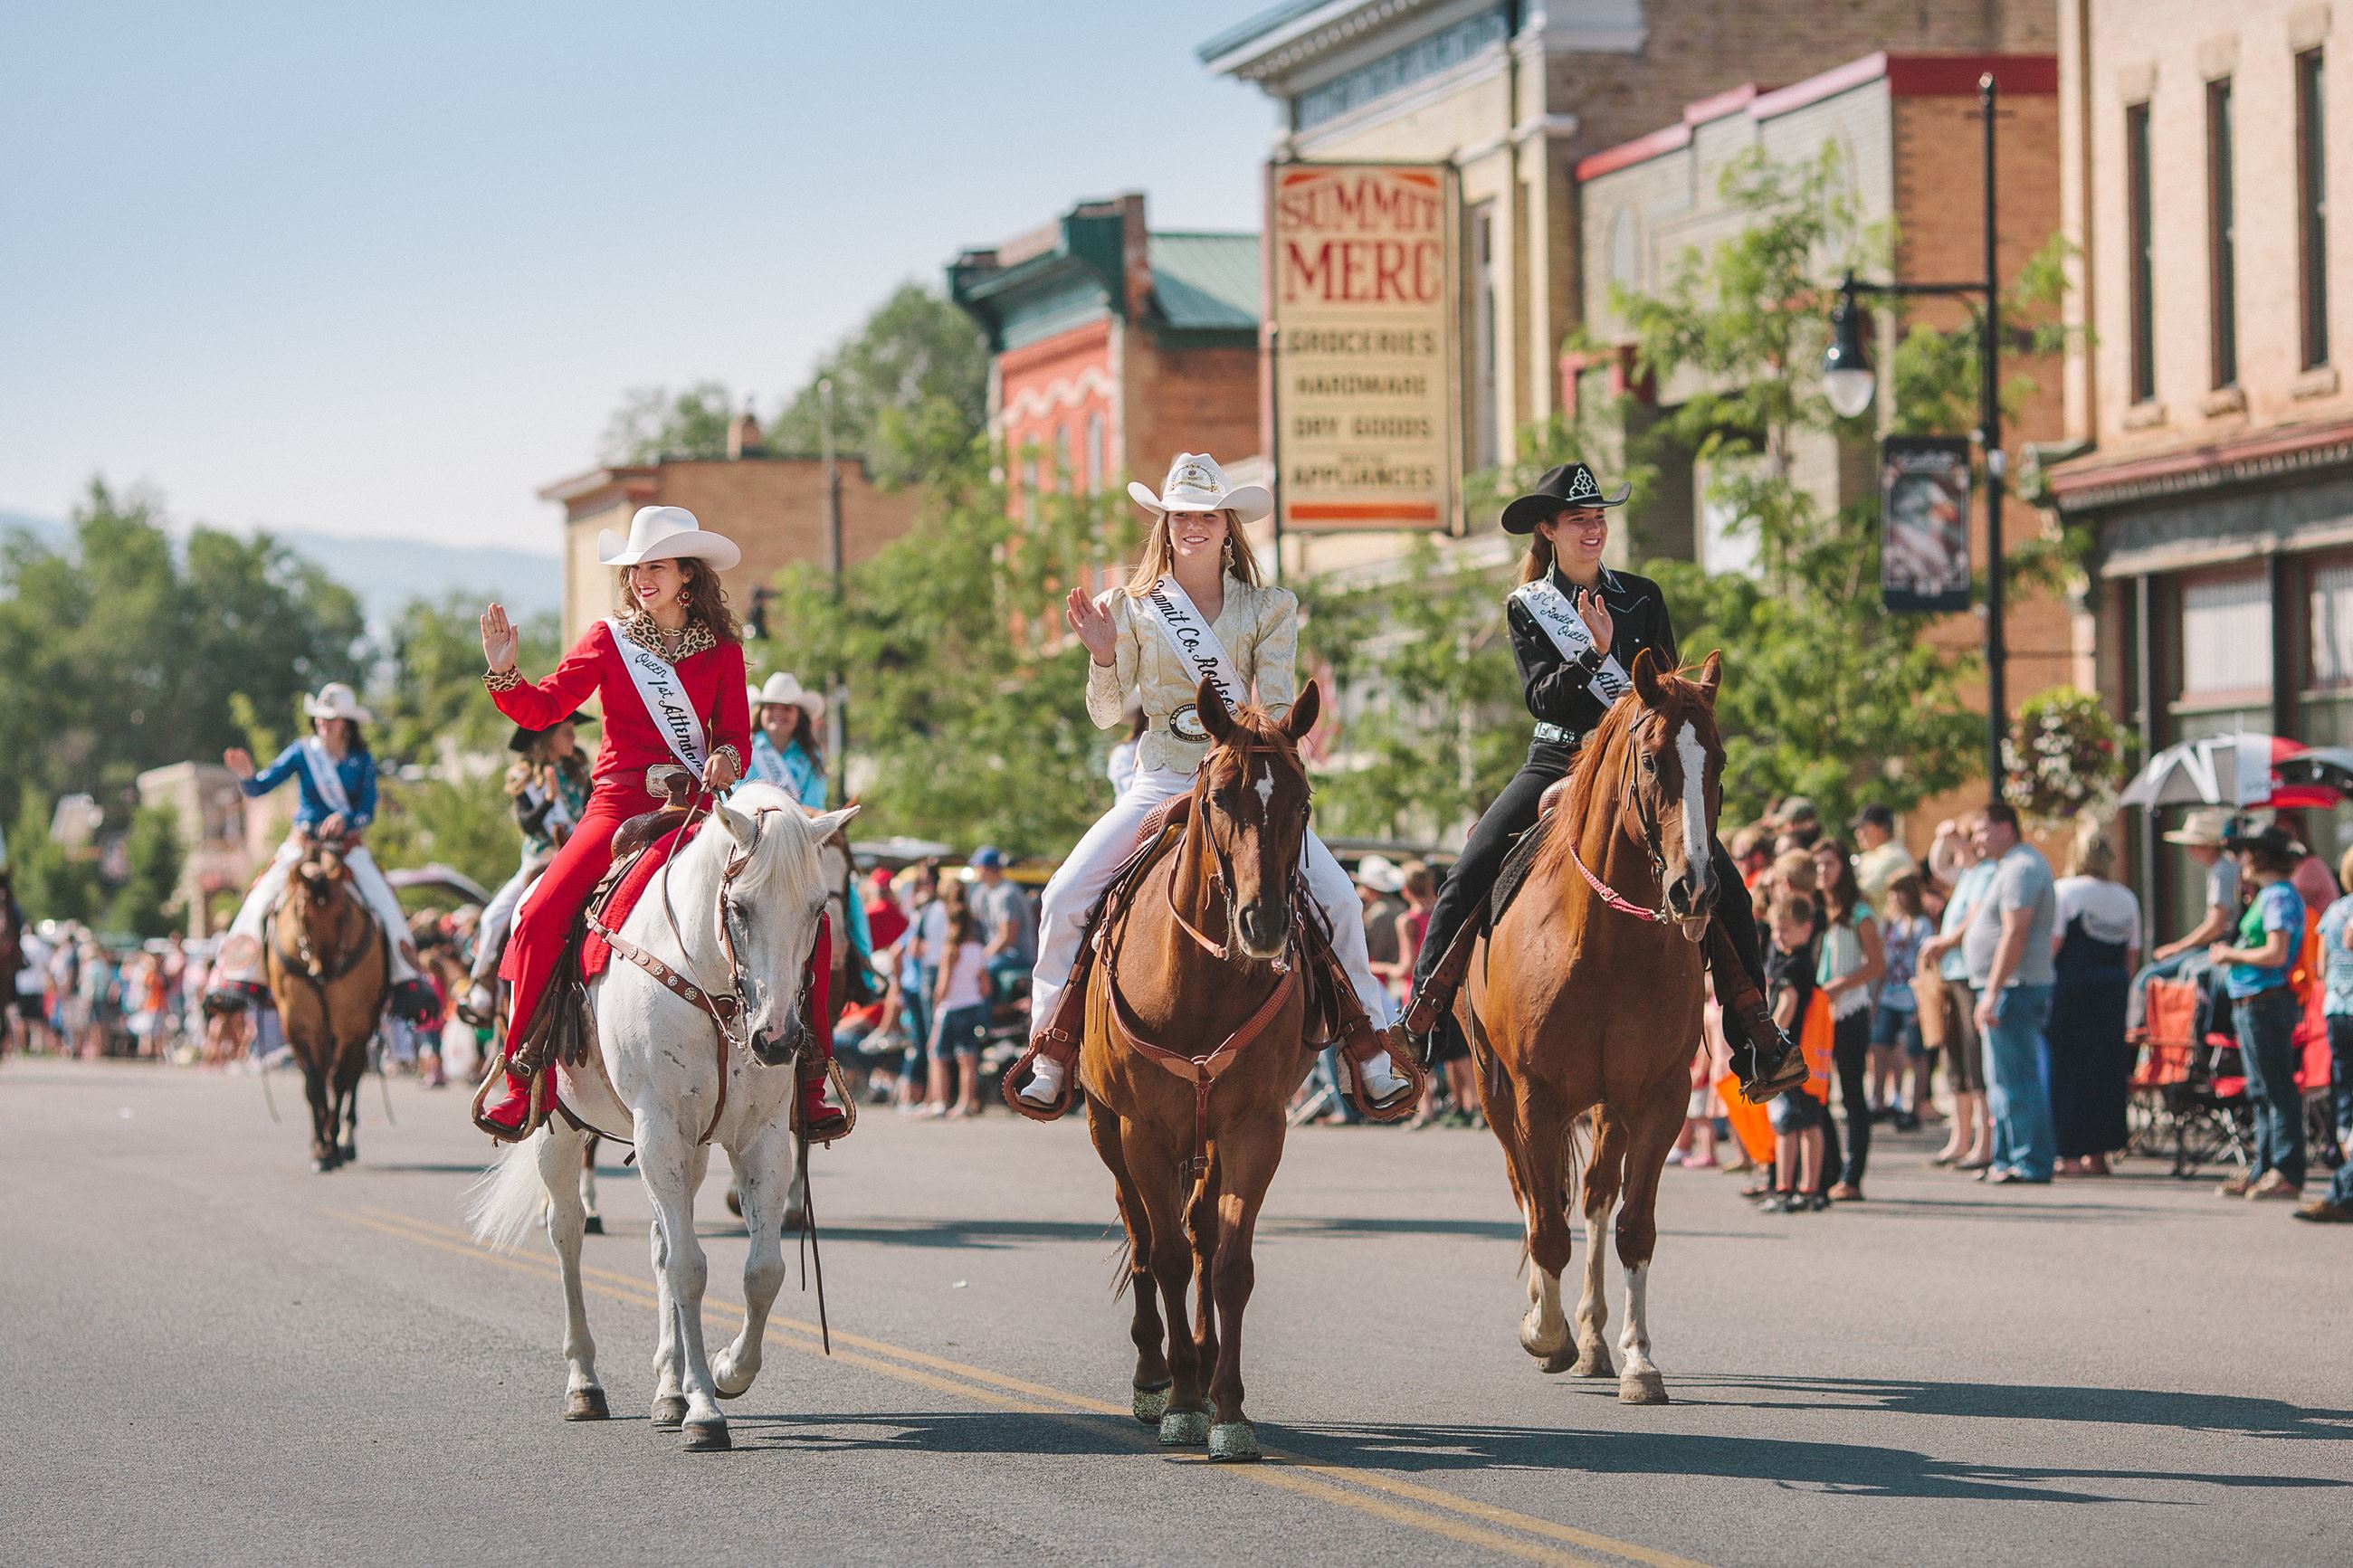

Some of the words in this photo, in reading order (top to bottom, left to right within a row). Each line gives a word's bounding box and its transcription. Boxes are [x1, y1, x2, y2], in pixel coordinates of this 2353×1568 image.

[1278, 179, 1443, 230] SUMMIT
[1285, 240, 1443, 302] MERC
[1289, 328, 1436, 356] GROCERIES
[1295, 374, 1427, 395] HARDWARE
[1292, 416, 1338, 438] DRY
[1351, 416, 1433, 438] GOODS
[1291, 465, 1435, 487] APPLIANCES
[1540, 607, 1576, 625] Rodeo
[1176, 627, 1200, 653] Co.
[1558, 626, 1589, 644] Queen
[635, 653, 667, 678] Queen
[658, 699, 704, 774] Attendan
